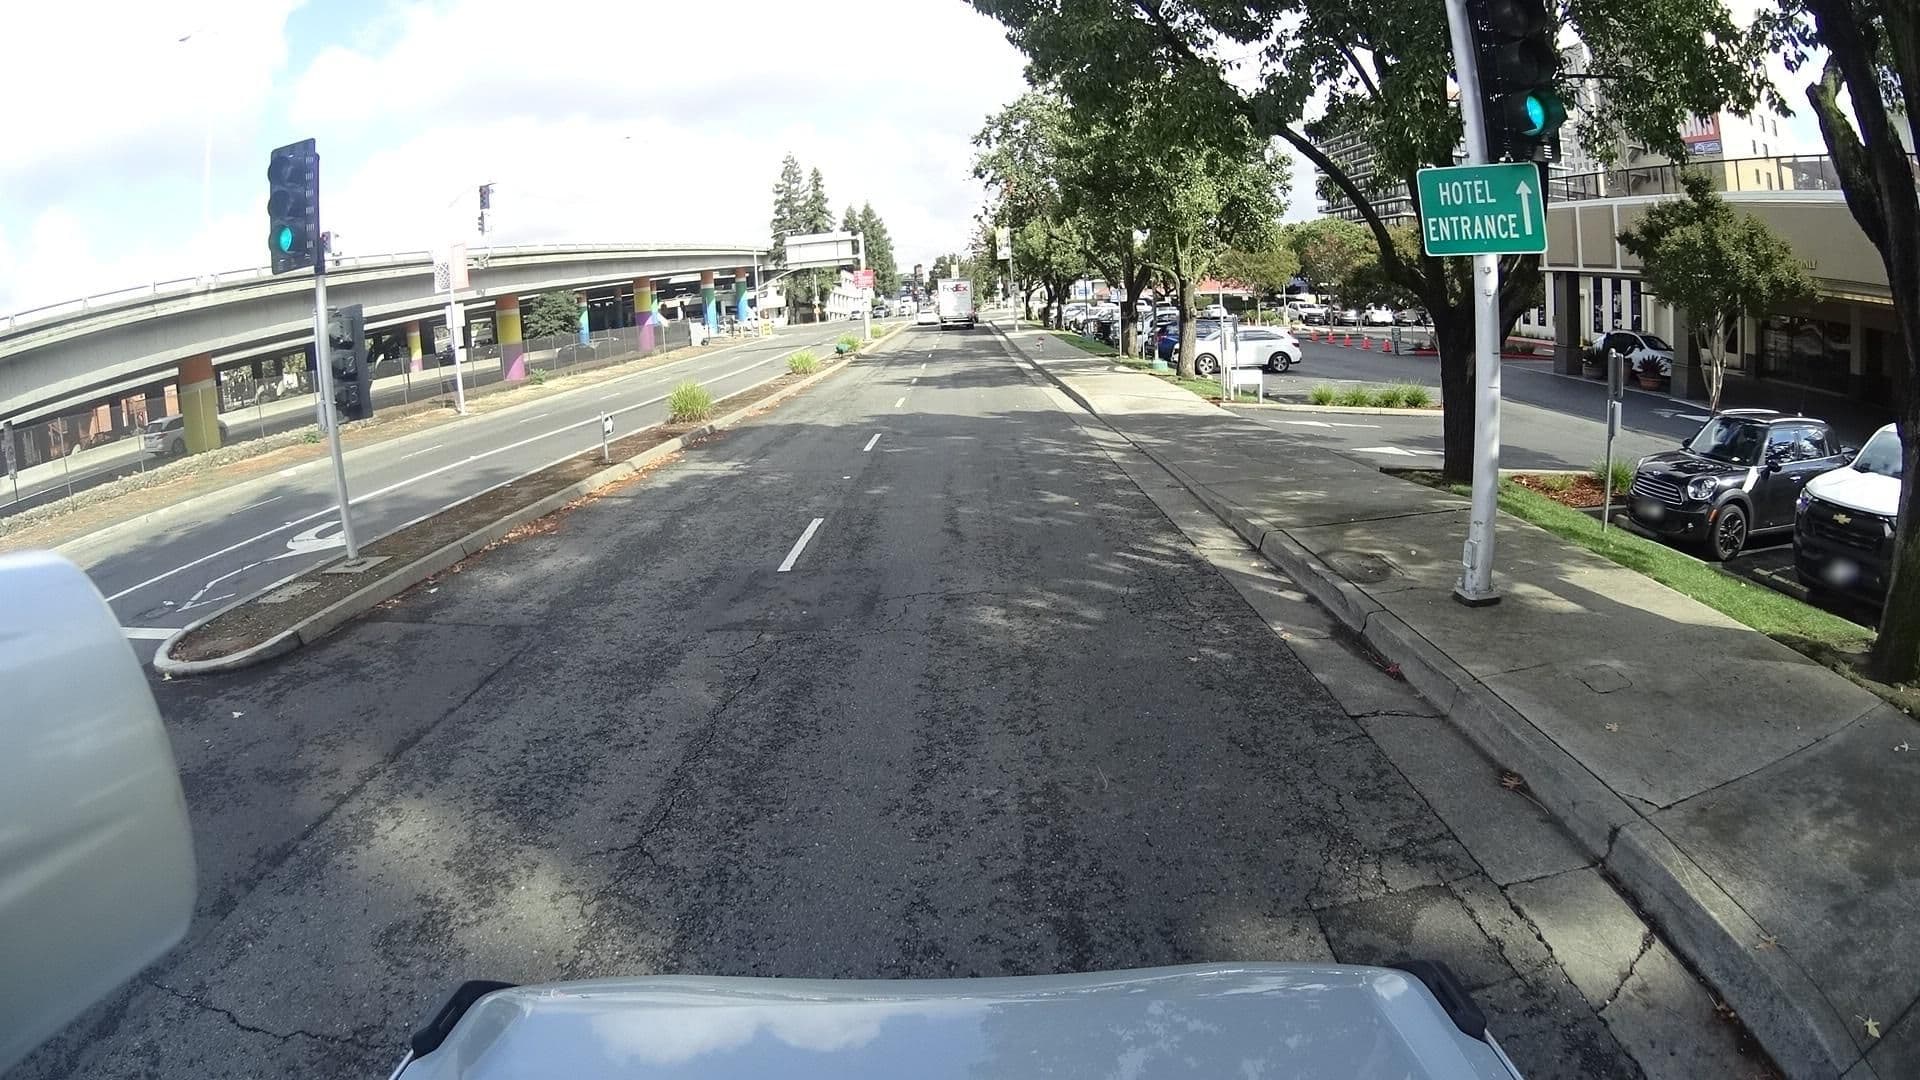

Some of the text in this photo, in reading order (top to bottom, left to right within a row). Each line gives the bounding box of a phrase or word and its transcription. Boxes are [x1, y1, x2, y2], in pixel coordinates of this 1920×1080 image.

[1438, 180, 1497, 206] HOTEL
[1428, 214, 1520, 242] ENTRANCE
[942, 283, 969, 293] FedEx
